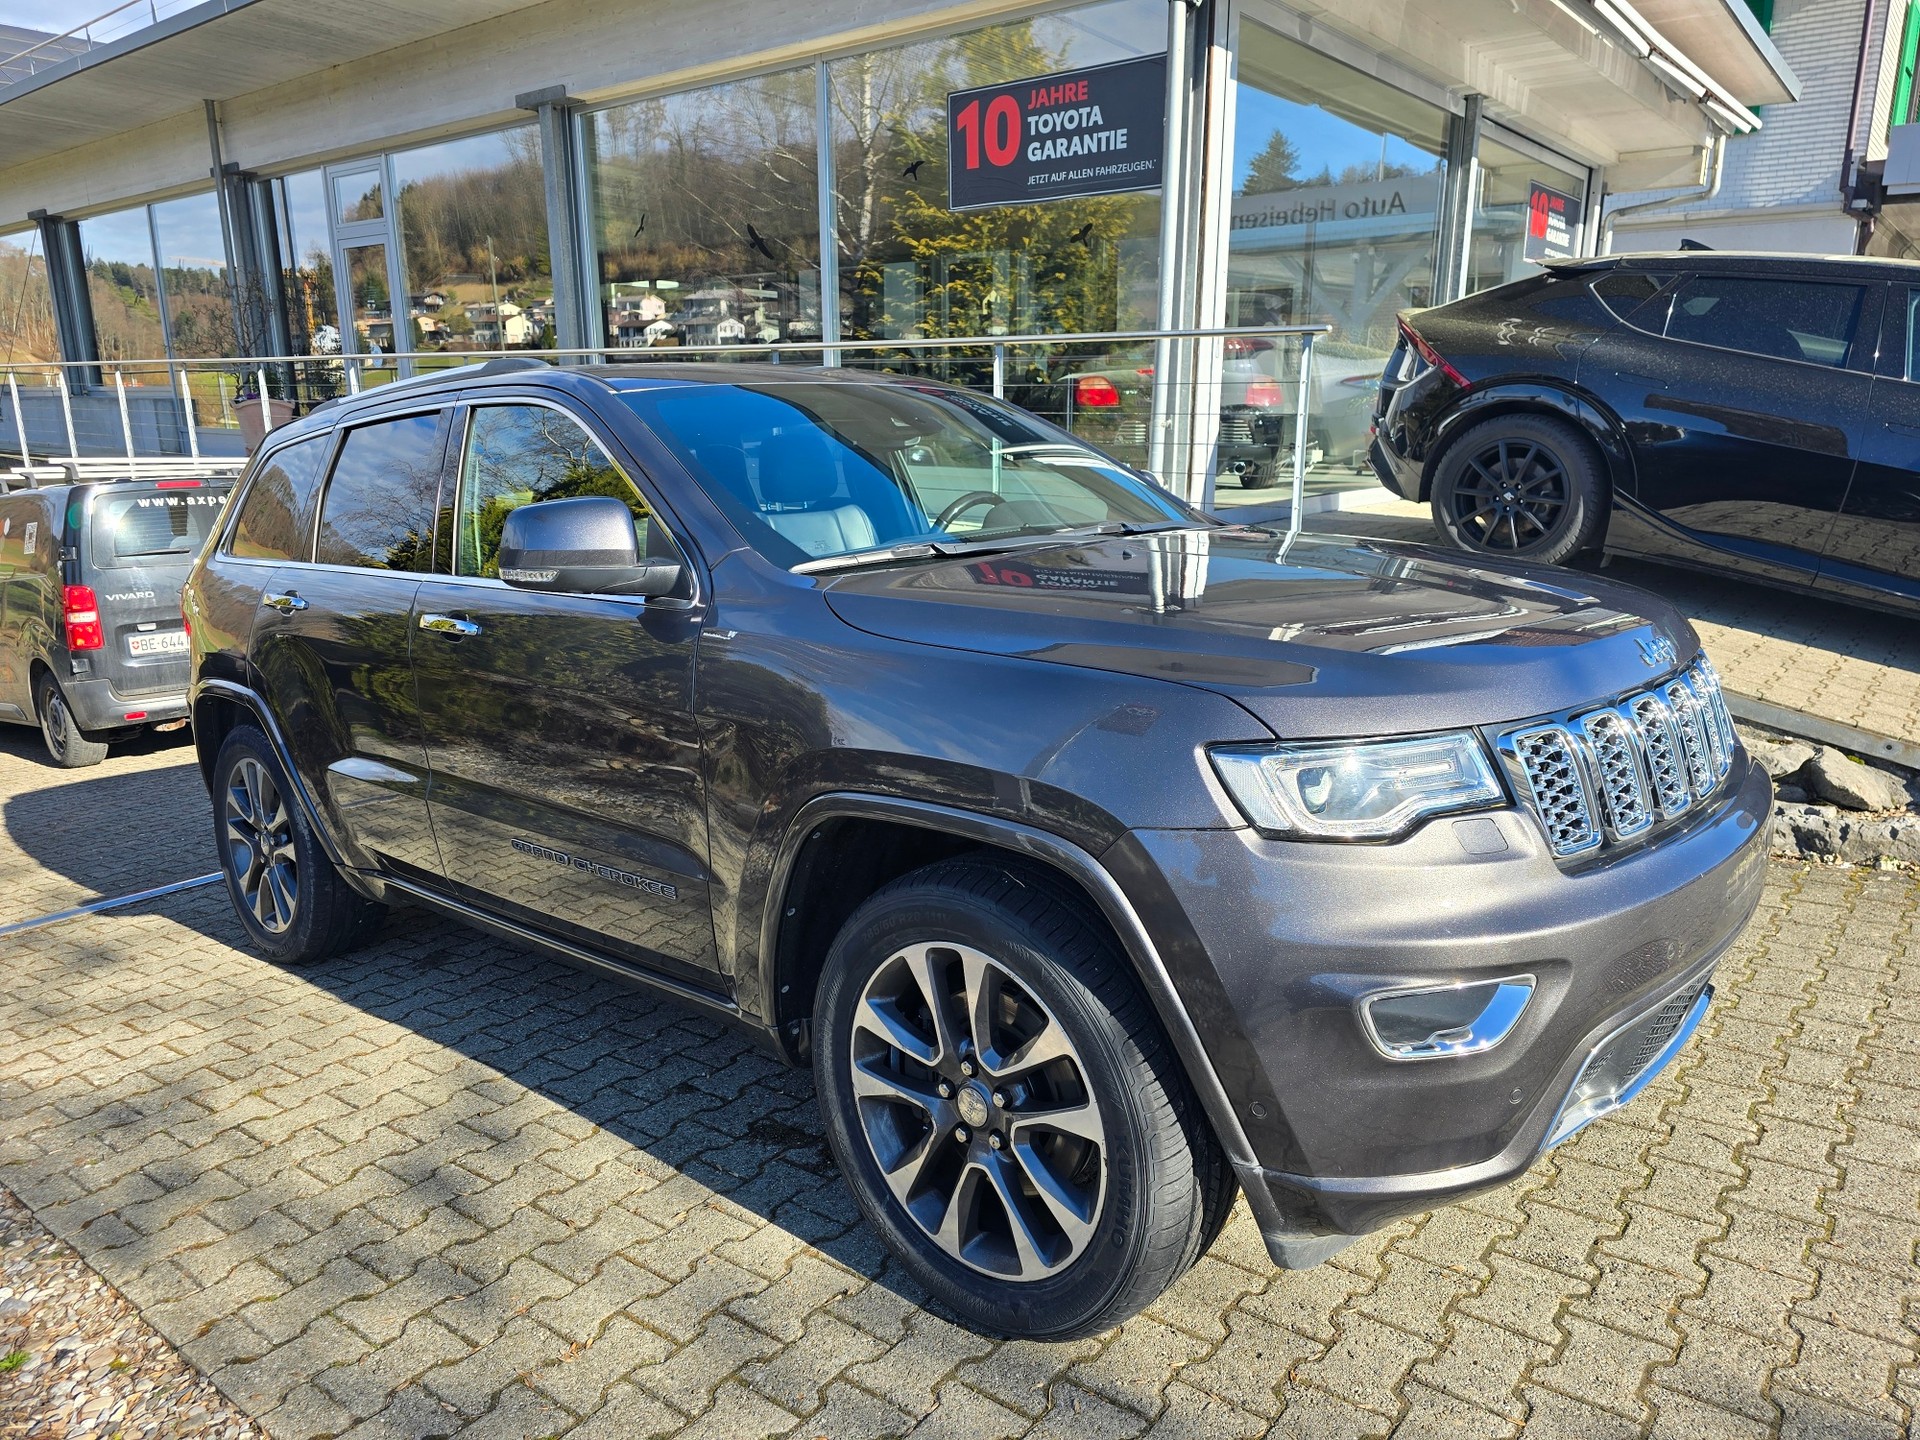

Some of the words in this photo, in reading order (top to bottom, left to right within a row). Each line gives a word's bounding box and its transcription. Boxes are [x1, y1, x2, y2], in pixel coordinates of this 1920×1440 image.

[1027, 80, 1089, 110] JAHRE
[956, 94, 1022, 170] 10
[1027, 105, 1103, 136] TOYOTA
[1027, 128, 1128, 162] GARANTIE
[1027, 173, 1049, 186] JETZT
[1050, 171, 1067, 182] AUF
[1067, 167, 1094, 181] ALLEN
[1530, 189, 1550, 239] 10
[137, 493, 230, 508] www.axpe
[105, 591, 155, 602] VIVARO
[1633, 635, 1678, 668] Jeep
[510, 838, 571, 866] GRAND
[572, 857, 678, 900] CHEROKEE
[1111, 1133, 1133, 1249] KUMHO
